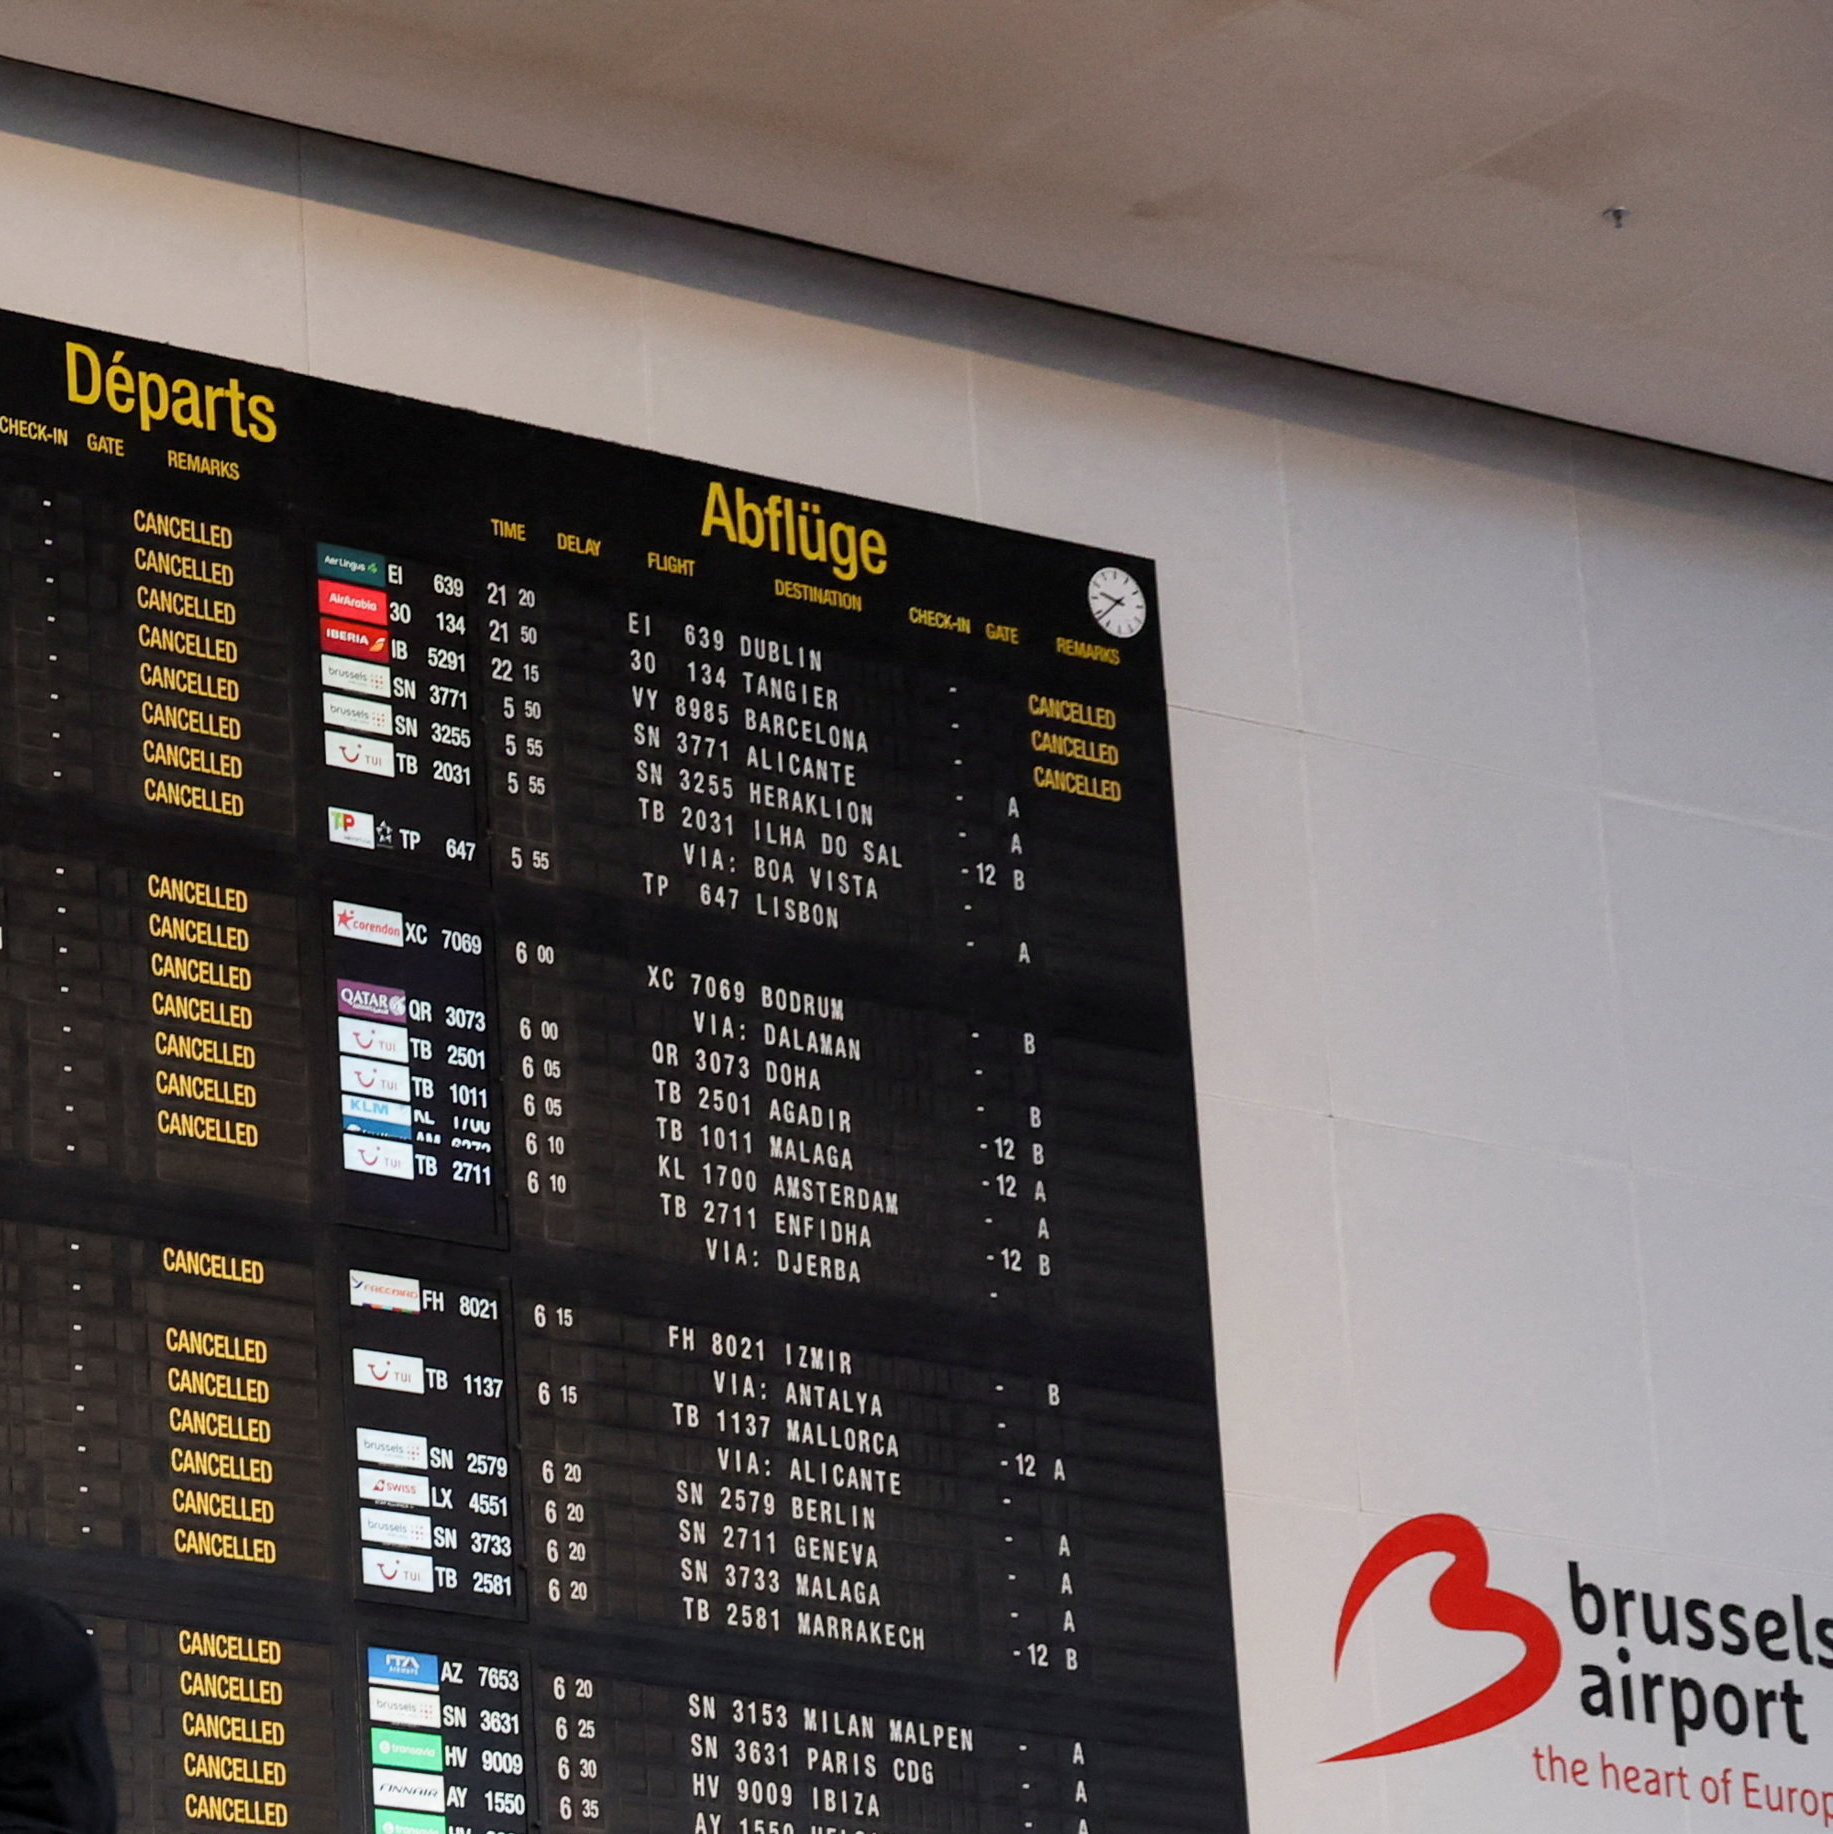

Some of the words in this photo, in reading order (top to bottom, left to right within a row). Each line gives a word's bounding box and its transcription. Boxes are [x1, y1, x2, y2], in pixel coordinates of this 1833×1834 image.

[66, 342, 276, 442] Départs
[0, 416, 67, 446] CHECK-IN
[87, 433, 124, 456] GATE
[168, 450, 240, 480] REMARKS
[701, 482, 887, 580] Abflüge
[491, 519, 526, 541] TIME
[558, 533, 601, 556] DELAY
[648, 552, 695, 576] FLIGHT
[775, 579, 862, 611] DESTINATION
[909, 607, 970, 634] CHECK-IN
[986, 623, 1018, 644] GATE
[1057, 637, 1120, 665] REMARKS
[741, 636, 821, 671] DUBLIN
[1029, 695, 1116, 730] CANCELLED
[743, 672, 837, 710] TANGIER
[745, 709, 867, 752] BARCELONA
[750, 782, 872, 826] HERAKLION
[755, 820, 805, 849] ILHA
[822, 833, 846, 857] DO
[864, 841, 902, 868] SAL
[148, 875, 247, 912] CANCELLED
[353, 919, 400, 936] corendon
[341, 987, 388, 1008] QATAR
[762, 986, 843, 1021] BODRUM
[765, 1023, 860, 1060] DALAMAN
[766, 1061, 820, 1090] DOHA
[770, 1099, 850, 1133] AGADIR
[774, 1174, 898, 1214] AMSTERDAM
[776, 1212, 871, 1247] ENFIDHA
[163, 1248, 263, 1284] CANCELLED
[786, 1343, 851, 1374] IZMIR
[786, 1382, 882, 1417] ANTALYA
[787, 1419, 898, 1457] MALLORCA
[792, 1497, 874, 1529] BERLIN
[795, 1535, 877, 1568] GENEVA
[798, 1612, 924, 1650] MARRAKECH
[1568, 1560, 1833, 1669] brussels
[1580, 1647, 1808, 1746] airport
[804, 1708, 873, 1738] MILAN
[890, 1719, 972, 1751] MALPEN
[1532, 1745, 1589, 1787] the
[1600, 1751, 1690, 1801] heart
[1701, 1767, 1732, 1805] of
[813, 1787, 879, 1816] IBIZA
